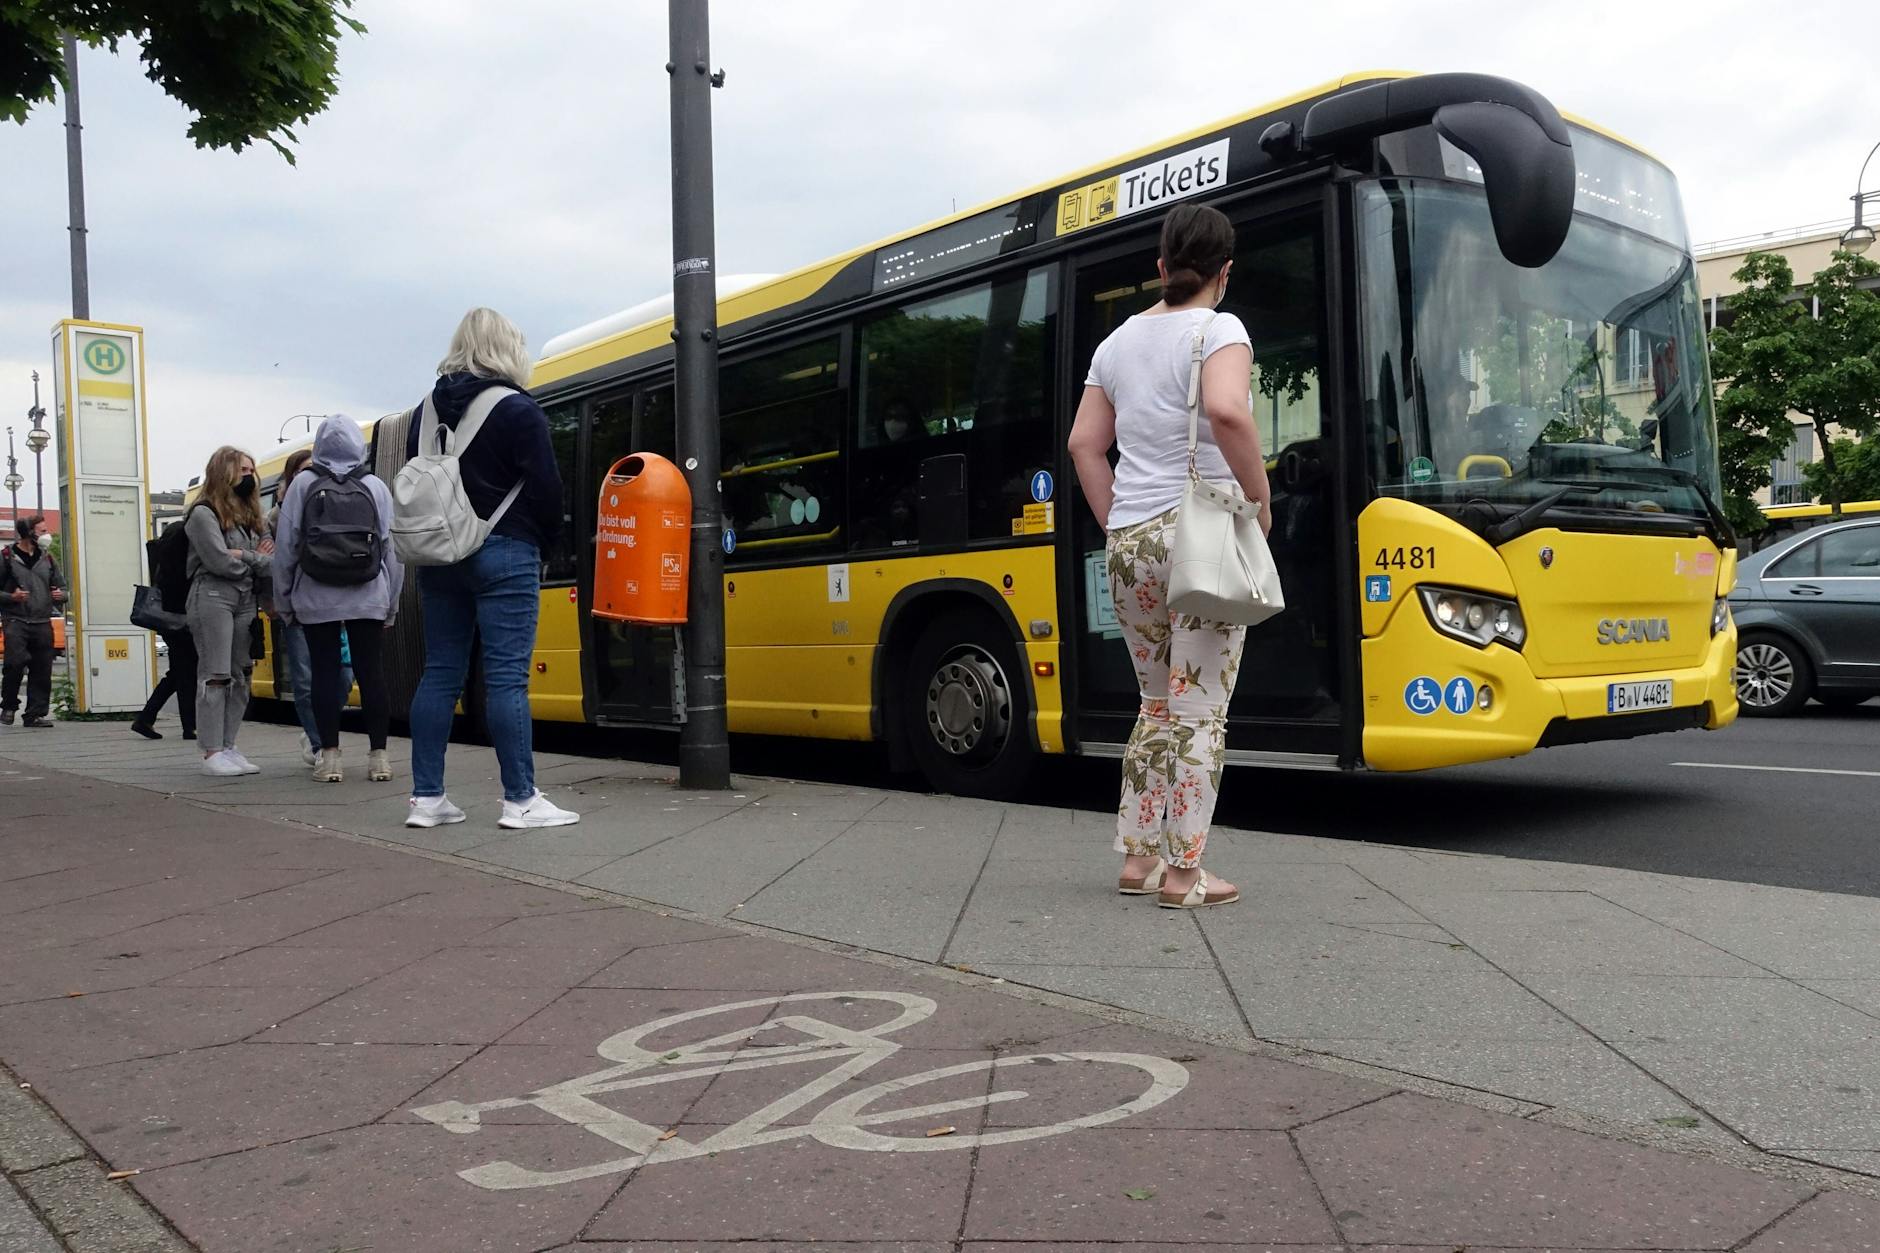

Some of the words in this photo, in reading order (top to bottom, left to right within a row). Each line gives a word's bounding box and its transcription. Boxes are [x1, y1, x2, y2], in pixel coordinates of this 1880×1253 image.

[1125, 156, 1220, 209] Tickets
[95, 346, 114, 367] H
[606, 514, 619, 528] bist
[620, 516, 636, 529] voll
[602, 529, 637, 548] Ordnung.
[664, 557, 680, 573] BSR
[1375, 546, 1435, 571] 4481
[1597, 618, 1671, 645] SCANIA
[108, 649, 127, 658] BVG
